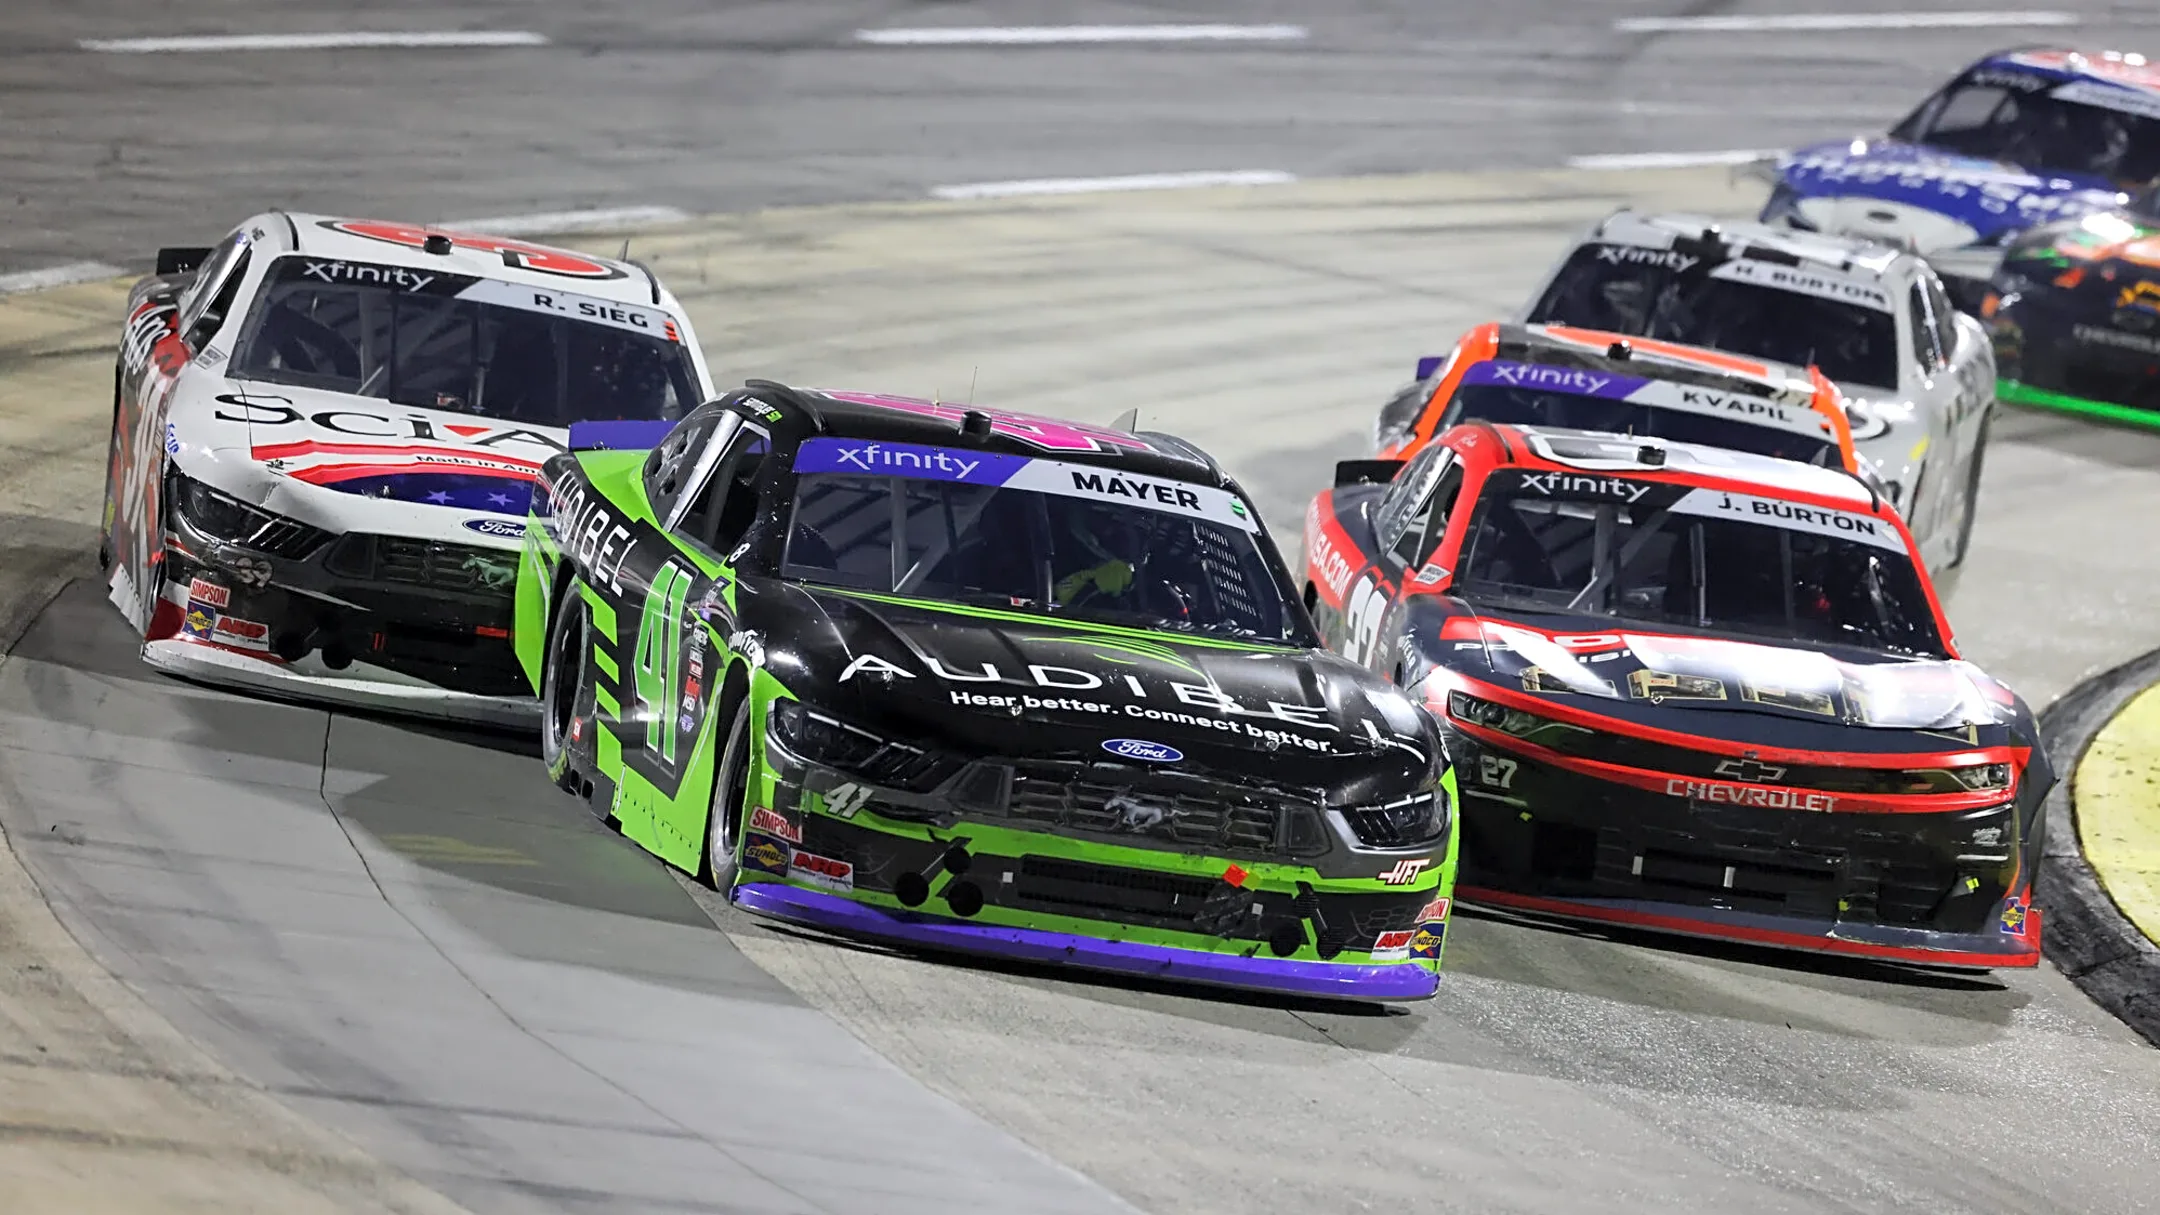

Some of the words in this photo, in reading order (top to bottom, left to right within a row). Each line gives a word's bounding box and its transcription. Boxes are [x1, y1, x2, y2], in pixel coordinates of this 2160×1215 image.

[304, 260, 435, 292] xfinity
[1597, 247, 1699, 273] xfinity
[1772, 271, 1886, 305] BURTON
[533, 293, 567, 310] R.
[579, 302, 649, 328] SIEG
[1493, 363, 1610, 394] xfinity
[1683, 390, 1794, 423] KVAPIL
[416, 454, 471, 466] Made
[477, 459, 496, 468] in
[503, 463, 536, 474] Am
[836, 443, 981, 479] xfinity
[1071, 471, 1203, 512] MAYER
[1520, 472, 1651, 503] xfinity
[1717, 492, 1743, 512] J.
[1751, 498, 1876, 536] BURTON
[545, 469, 638, 598] AUDIBEL
[190, 580, 227, 605] SIMPSON
[634, 558, 694, 766] 41
[950, 690, 1016, 708] Hear
[1023, 694, 1119, 715] better.
[1125, 703, 1241, 734] Connect
[1245, 722, 1339, 754] better.
[1116, 740, 1168, 760] Ford
[1480, 754, 1518, 789] 27
[823, 782, 874, 819] 41
[1666, 779, 1840, 814] CHEVROLET
[752, 809, 800, 841] SIMPSON
[792, 852, 851, 878] ARP
[1377, 858, 1431, 885] HFT
